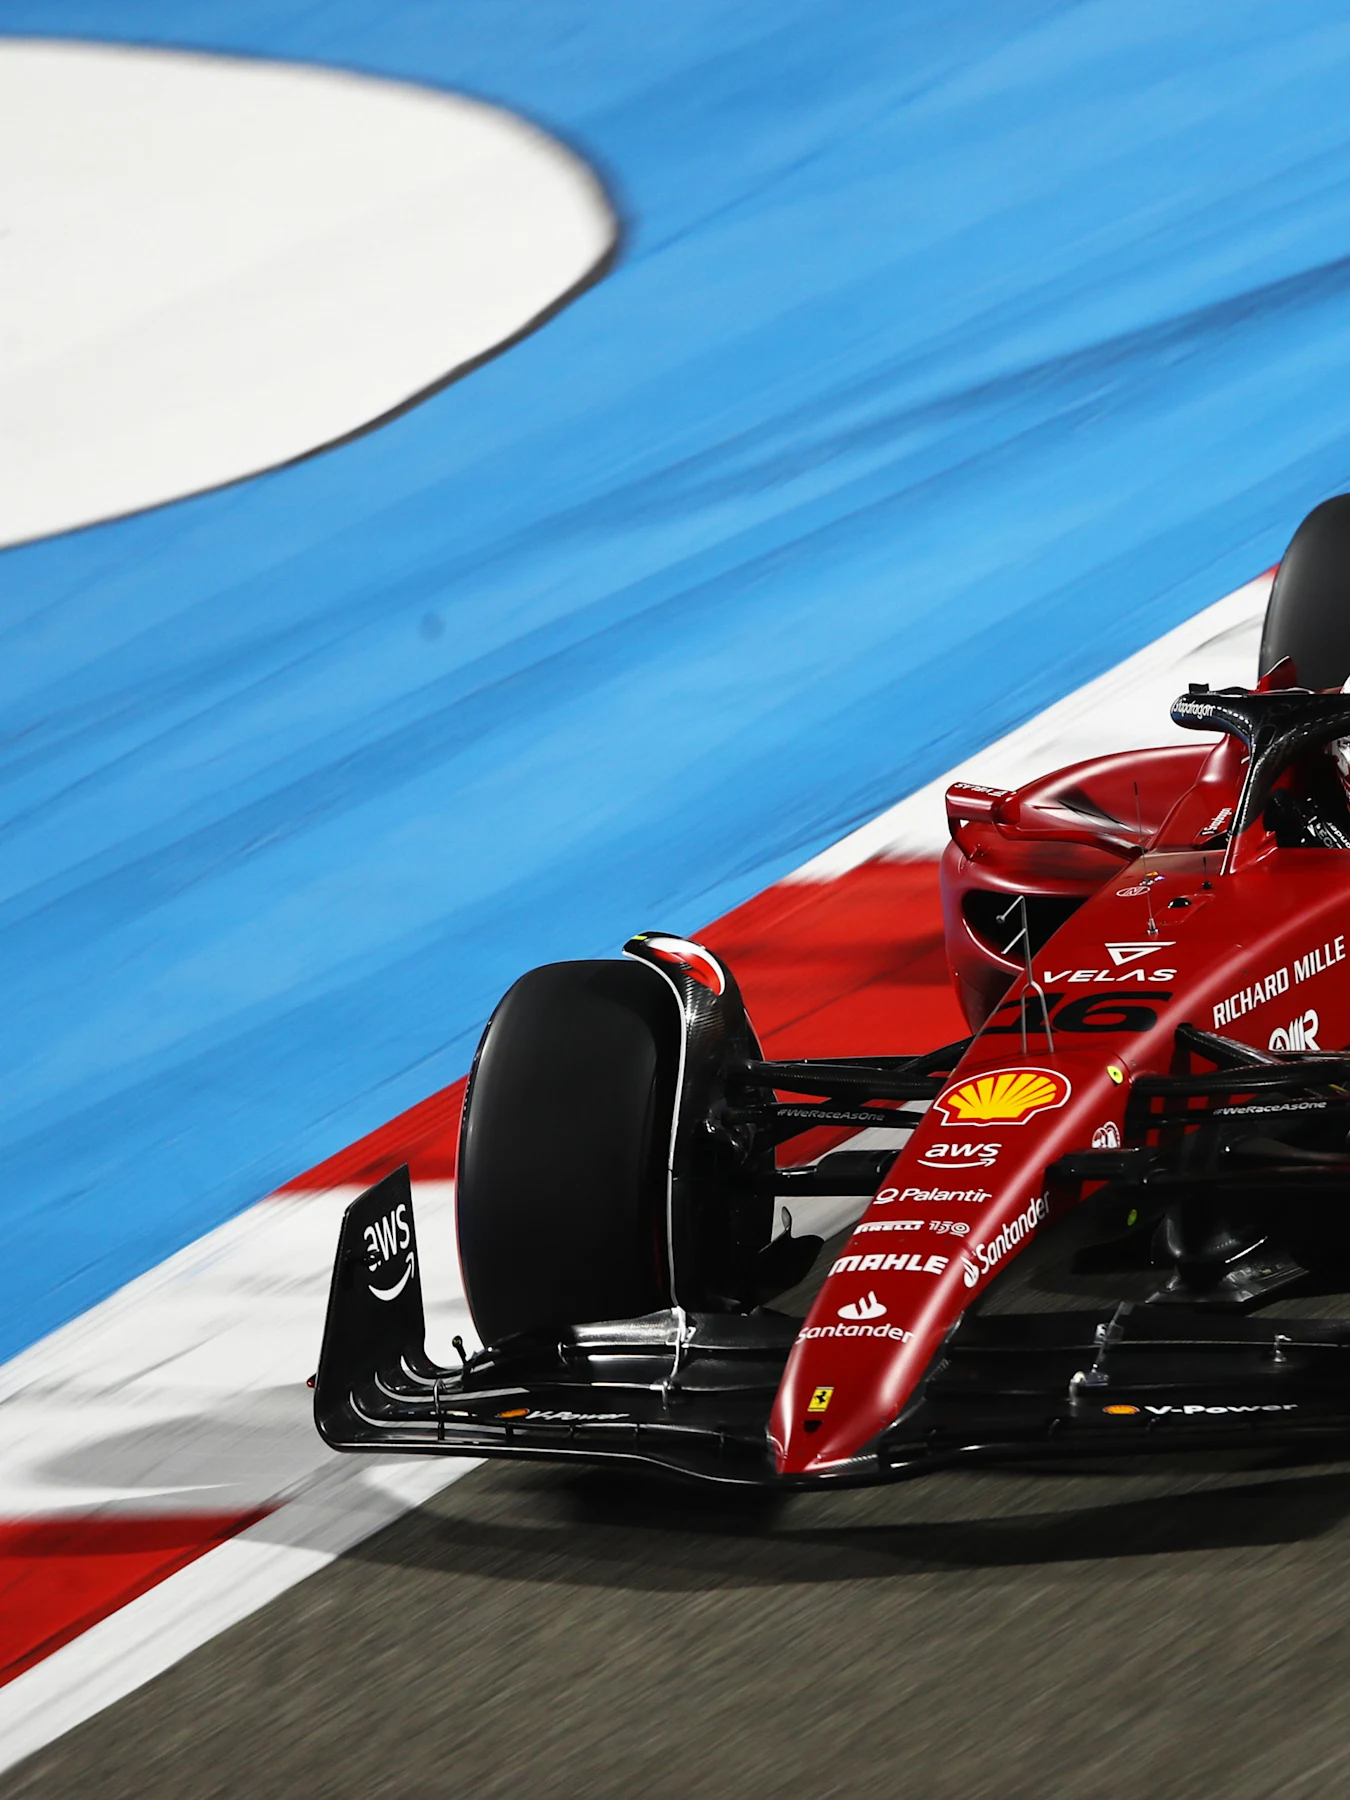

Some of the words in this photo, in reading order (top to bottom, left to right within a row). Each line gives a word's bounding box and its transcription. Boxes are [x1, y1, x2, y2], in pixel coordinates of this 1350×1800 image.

[1044, 969, 1177, 983] VELAS
[1213, 966, 1291, 1029] RICHARD
[1294, 935, 1347, 982] MILLE
[983, 991, 1173, 1035] 16
[777, 1108, 886, 1121] #WeRaceAsOne
[1212, 1101, 1328, 1116] #WeRaceAsOne
[924, 1143, 1002, 1158] aws
[900, 1187, 993, 1203] Palantir
[853, 1220, 925, 1235] PIRELLI
[976, 1191, 1050, 1276] Santander
[363, 1203, 411, 1271] aws
[828, 1253, 950, 1277] MAHLE
[795, 1322, 915, 1344] Santander
[525, 1410, 631, 1421] V-Power
[1144, 1404, 1299, 1415] V-Power
